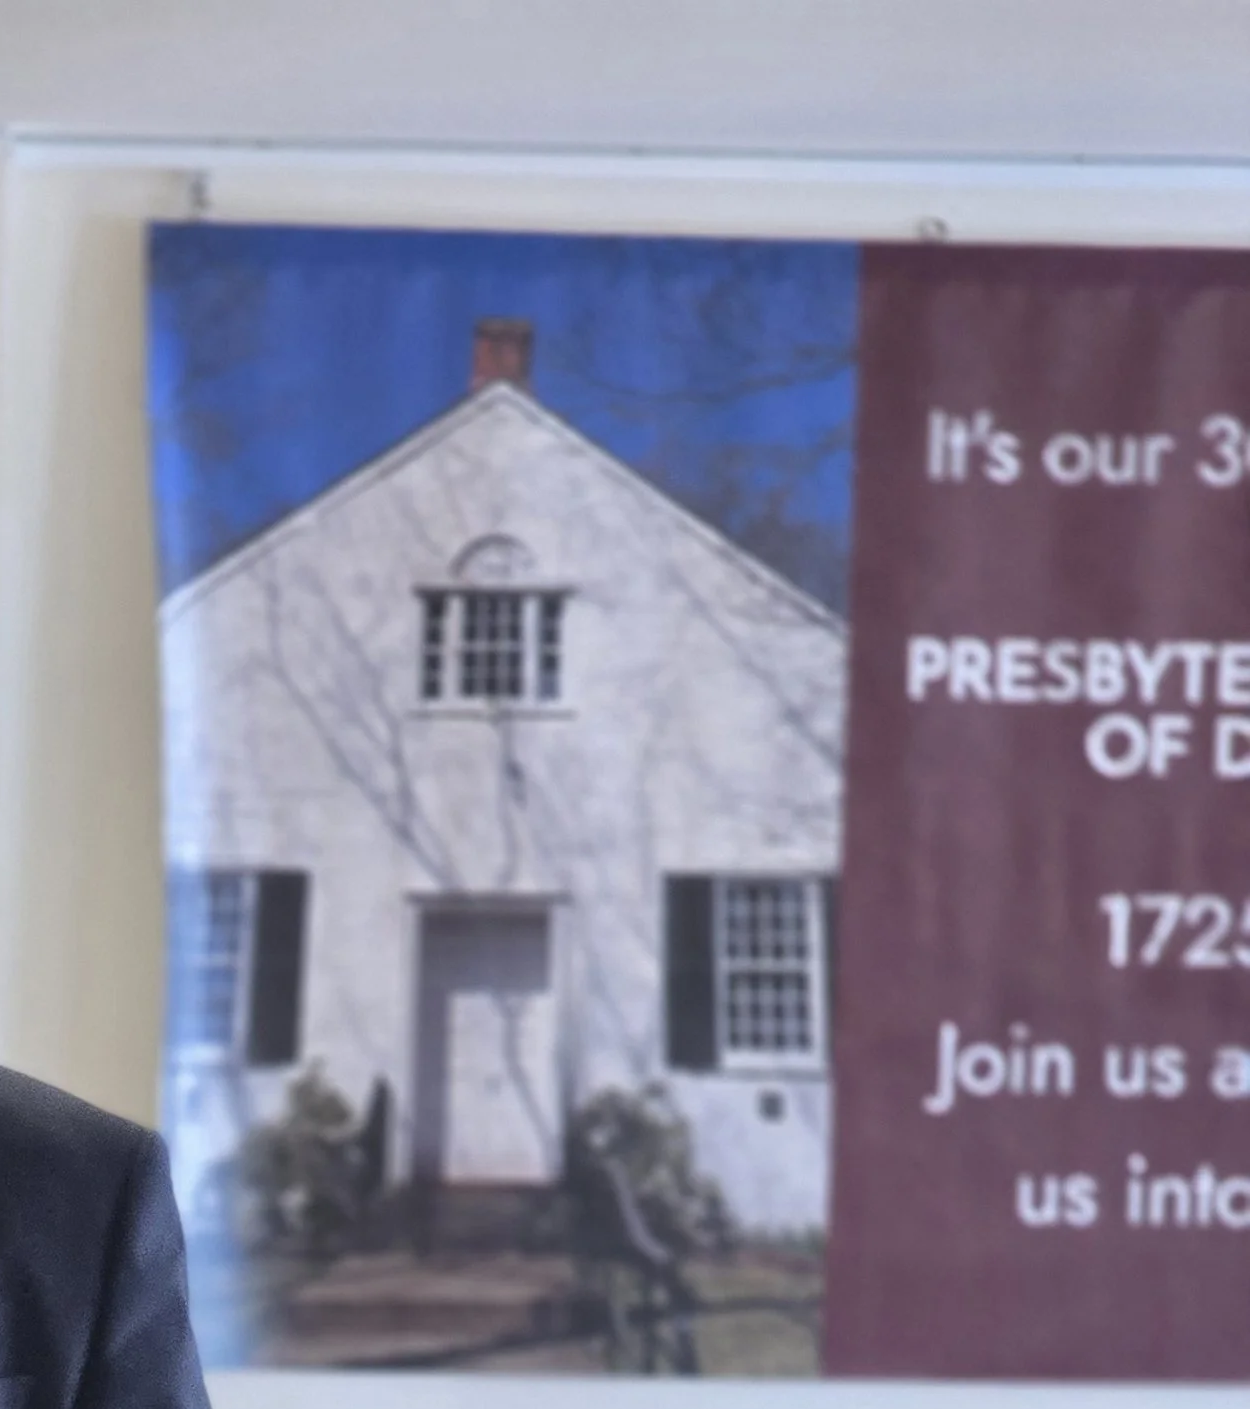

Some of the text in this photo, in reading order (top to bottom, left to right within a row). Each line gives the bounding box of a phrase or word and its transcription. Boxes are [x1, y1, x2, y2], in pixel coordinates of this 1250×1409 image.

[928, 411, 1250, 488] It's our 3
[906, 635, 1250, 706] PRESBYTE
[1084, 712, 1193, 779] OF
[923, 1021, 1250, 1115] Join us a
[1016, 1153, 1250, 1229] us into
